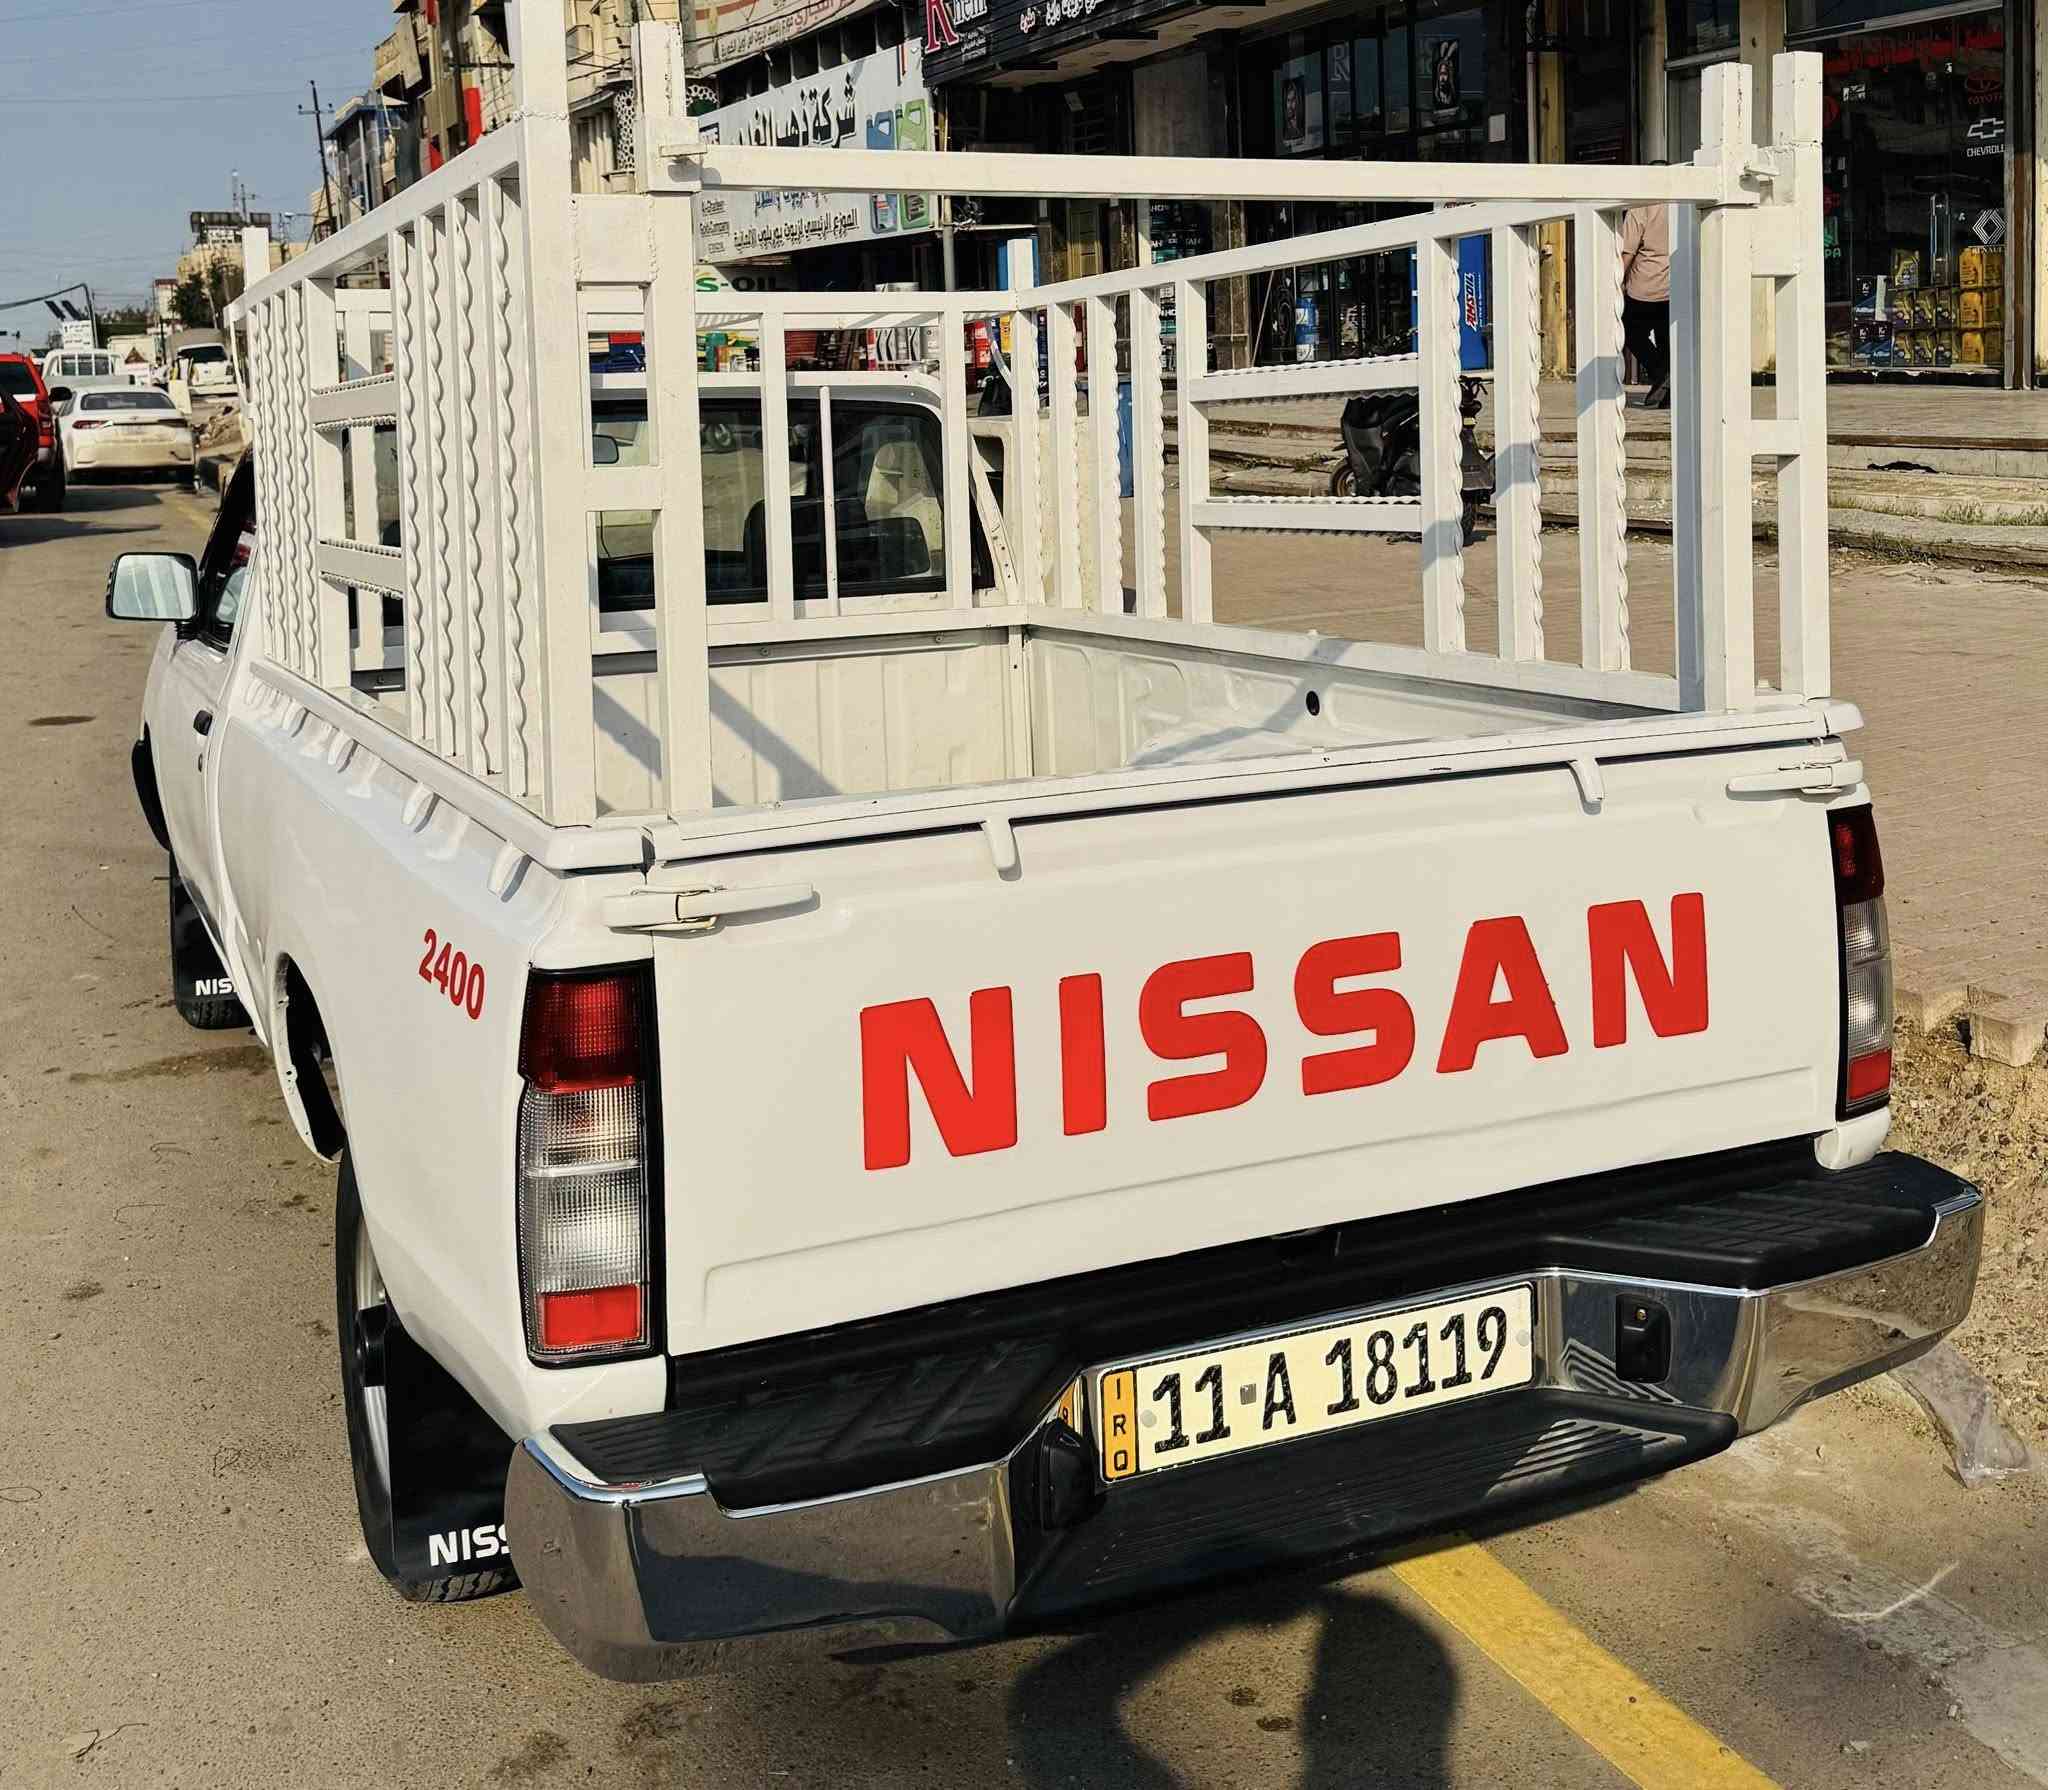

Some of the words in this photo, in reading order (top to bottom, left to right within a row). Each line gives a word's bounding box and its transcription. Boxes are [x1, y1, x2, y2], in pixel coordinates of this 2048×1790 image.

[1464, 272, 1478, 332] AMSOIL
[419, 928, 486, 1020] 2400
[860, 892, 1709, 1171] NISSAN
[1110, 1376, 1129, 1472] IRQ
[1151, 1363, 1231, 1453] 11
[1261, 1351, 1298, 1431] A
[1325, 1305, 1508, 1416] 18119
